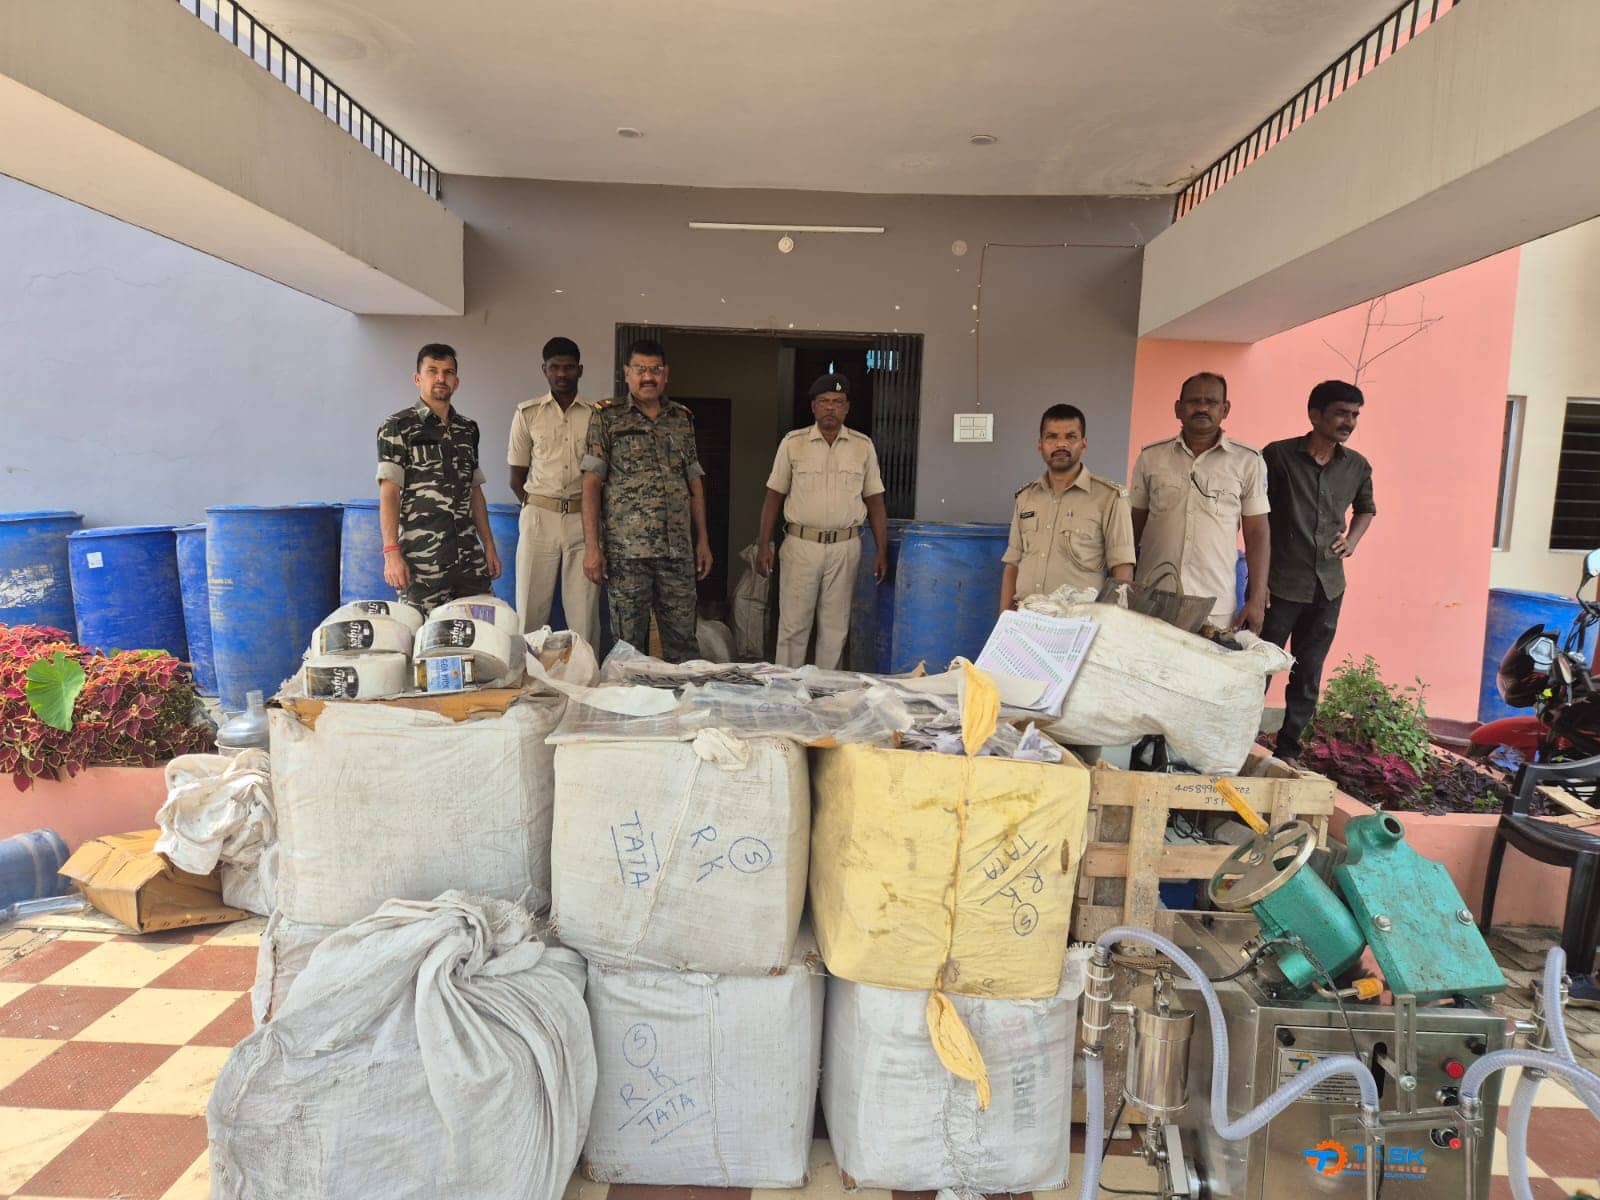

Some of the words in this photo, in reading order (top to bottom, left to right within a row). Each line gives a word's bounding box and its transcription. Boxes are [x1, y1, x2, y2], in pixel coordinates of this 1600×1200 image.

[347, 622, 361, 648] Tiger
[450, 619, 464, 644] Tiger
[620, 809, 650, 888] TATA
[983, 834, 1038, 880] TATA
[637, 1093, 697, 1132] TATA
